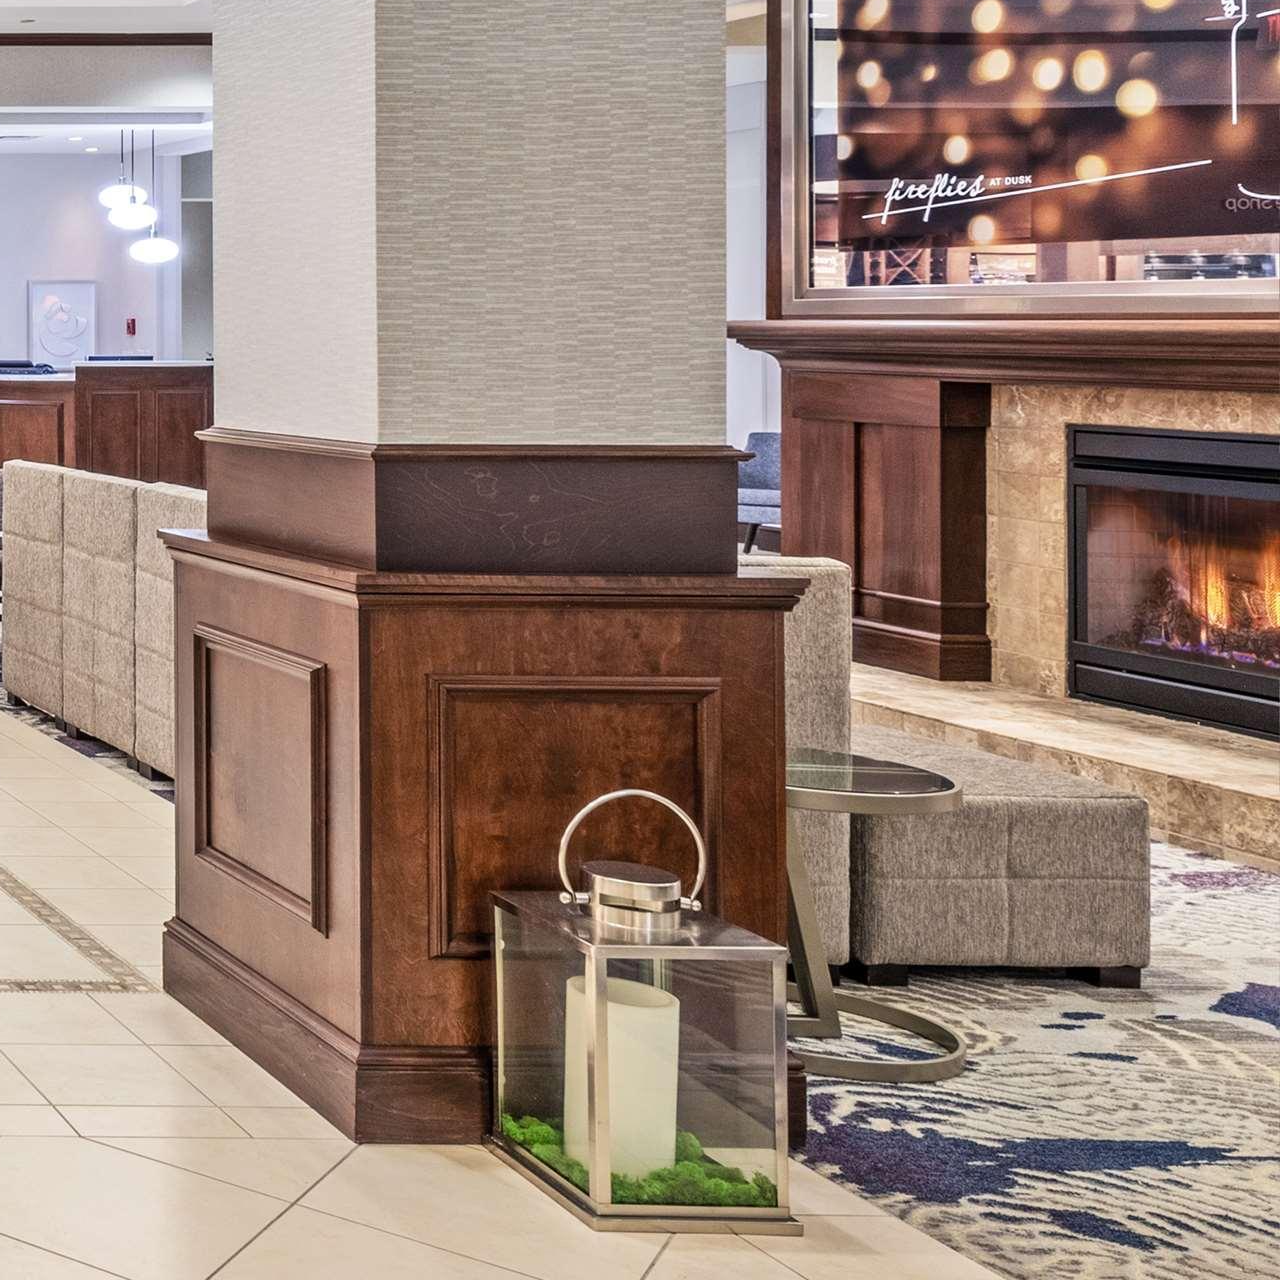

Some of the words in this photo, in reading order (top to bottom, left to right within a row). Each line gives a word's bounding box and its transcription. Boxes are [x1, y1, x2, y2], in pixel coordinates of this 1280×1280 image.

[881, 173, 986, 225] fireflies
[989, 177, 1001, 187] AT
[1004, 175, 1033, 186] DUSK
